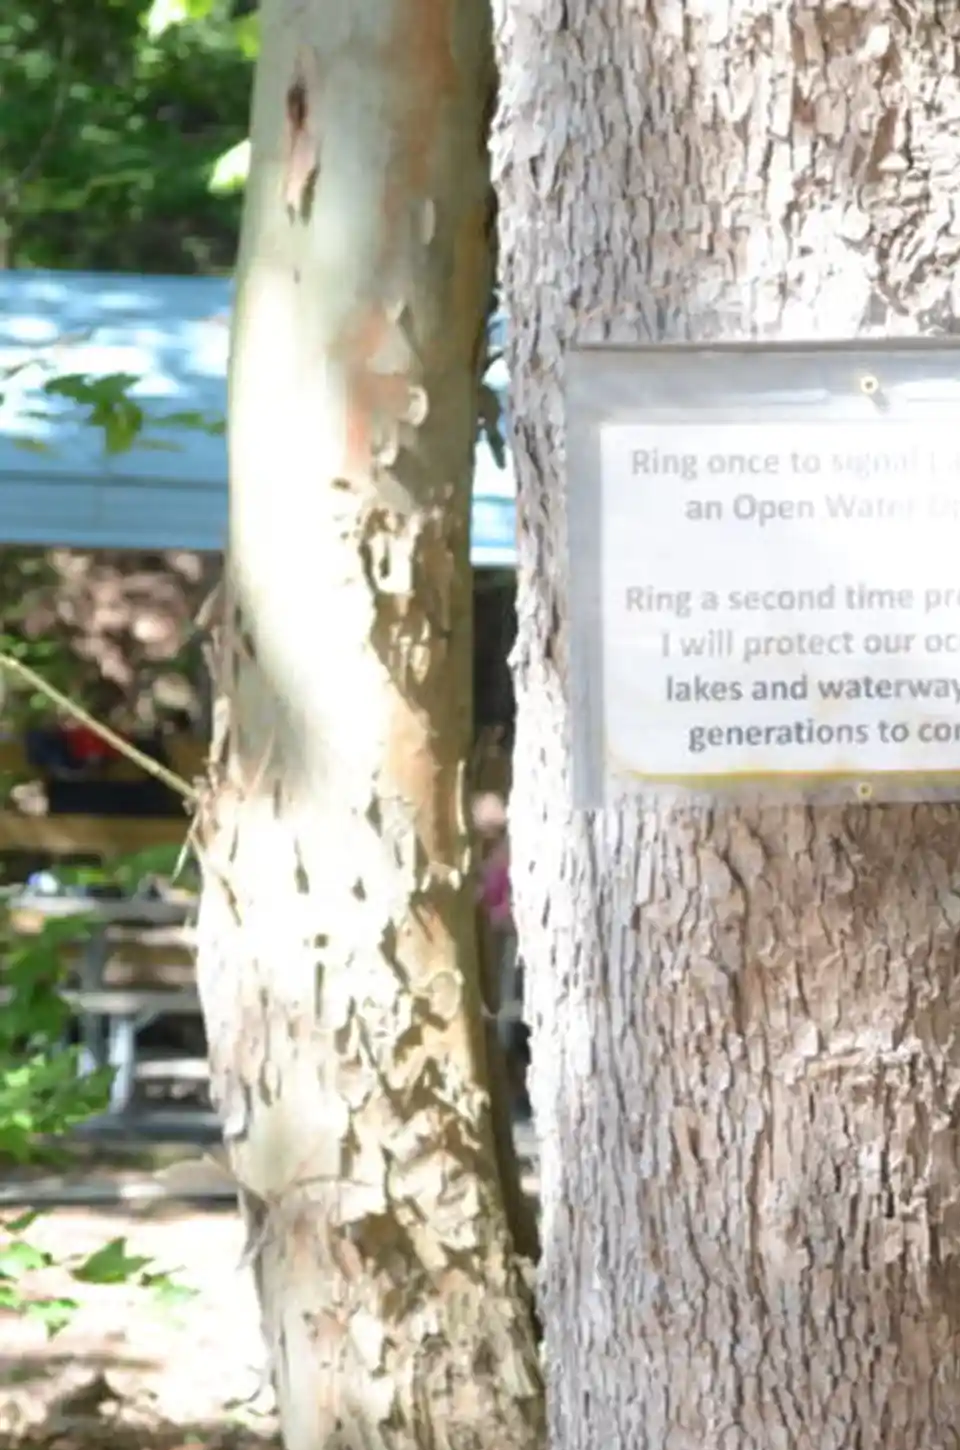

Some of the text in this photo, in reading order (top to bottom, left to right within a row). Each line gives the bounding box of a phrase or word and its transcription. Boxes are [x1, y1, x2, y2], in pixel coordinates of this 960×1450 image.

[631, 449, 697, 479] Ring
[707, 453, 779, 474] once
[790, 451, 821, 474] to
[685, 500, 722, 520] an
[733, 493, 815, 526] Open
[825, 493, 917, 520] Water
[625, 585, 691, 617] Ring
[701, 590, 719, 609] a
[729, 583, 835, 610] second
[845, 582, 914, 609] time
[661, 633, 669, 658] I
[680, 629, 732, 657] will
[743, 630, 855, 663] protect
[864, 634, 916, 654] our
[666, 675, 742, 701] lakes
[751, 672, 808, 700] and
[688, 718, 869, 752] generations
[878, 720, 909, 742] to
